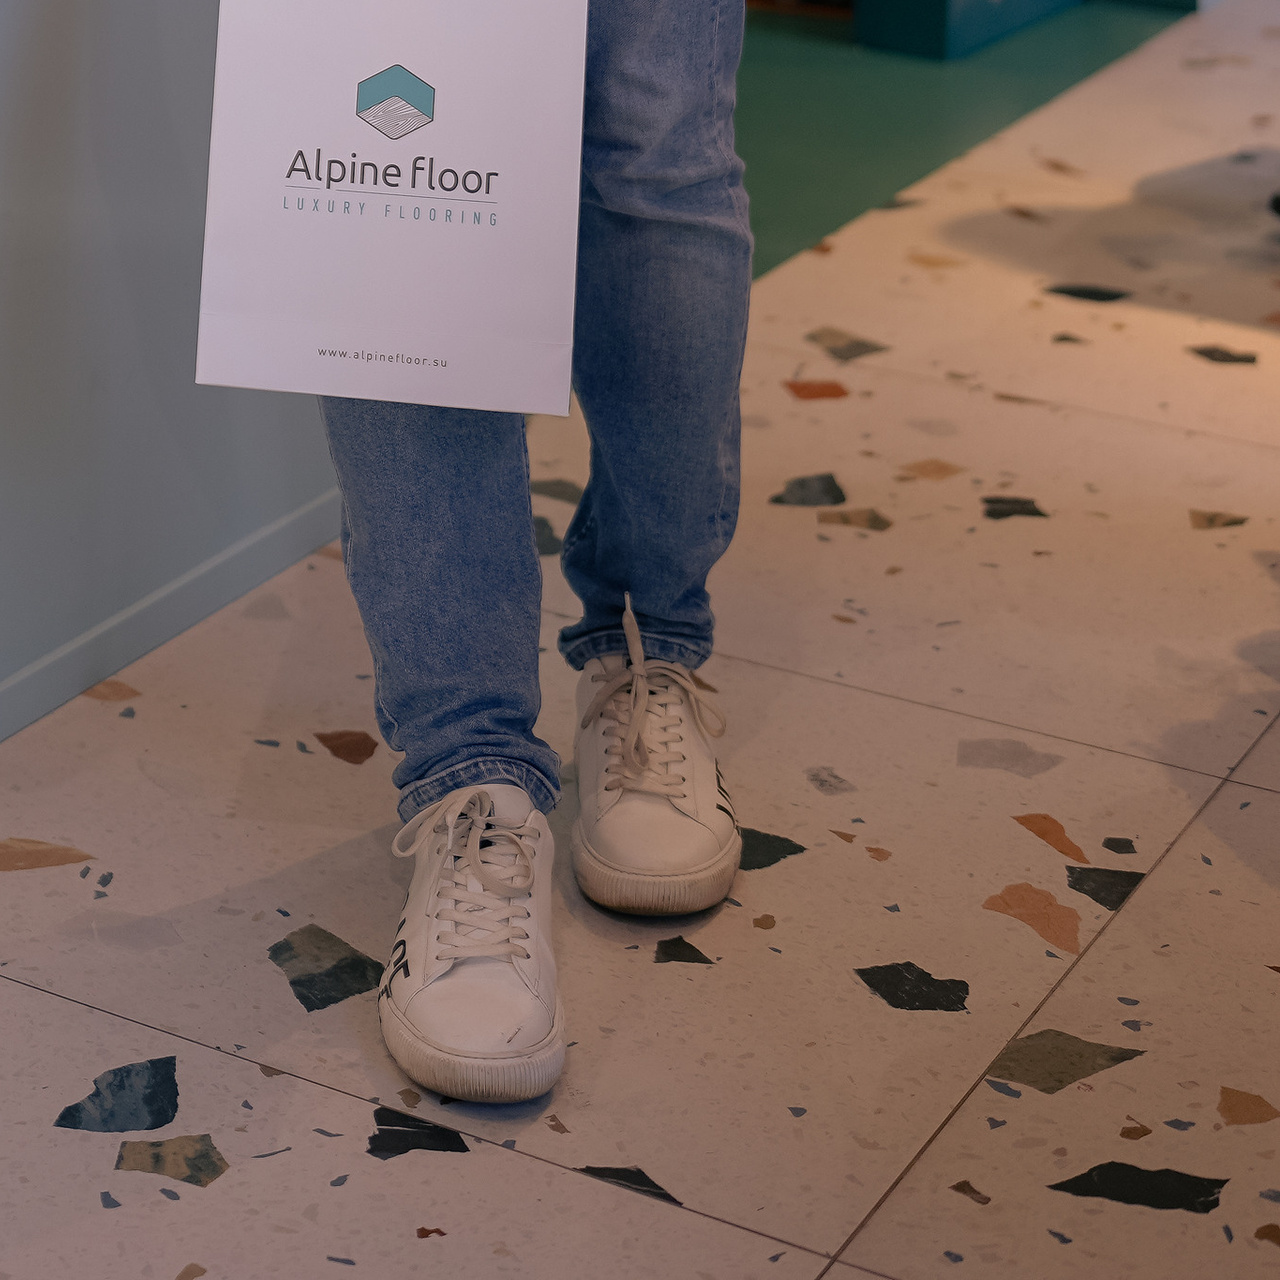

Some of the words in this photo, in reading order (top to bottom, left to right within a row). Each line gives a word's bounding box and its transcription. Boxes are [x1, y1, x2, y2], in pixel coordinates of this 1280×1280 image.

[285, 147, 403, 192] Alpine
[409, 154, 500, 196] floor
[282, 195, 367, 217] LUXURY
[383, 203, 500, 228] FLOORING
[317, 345, 449, 369] www.alpinefloor.su
